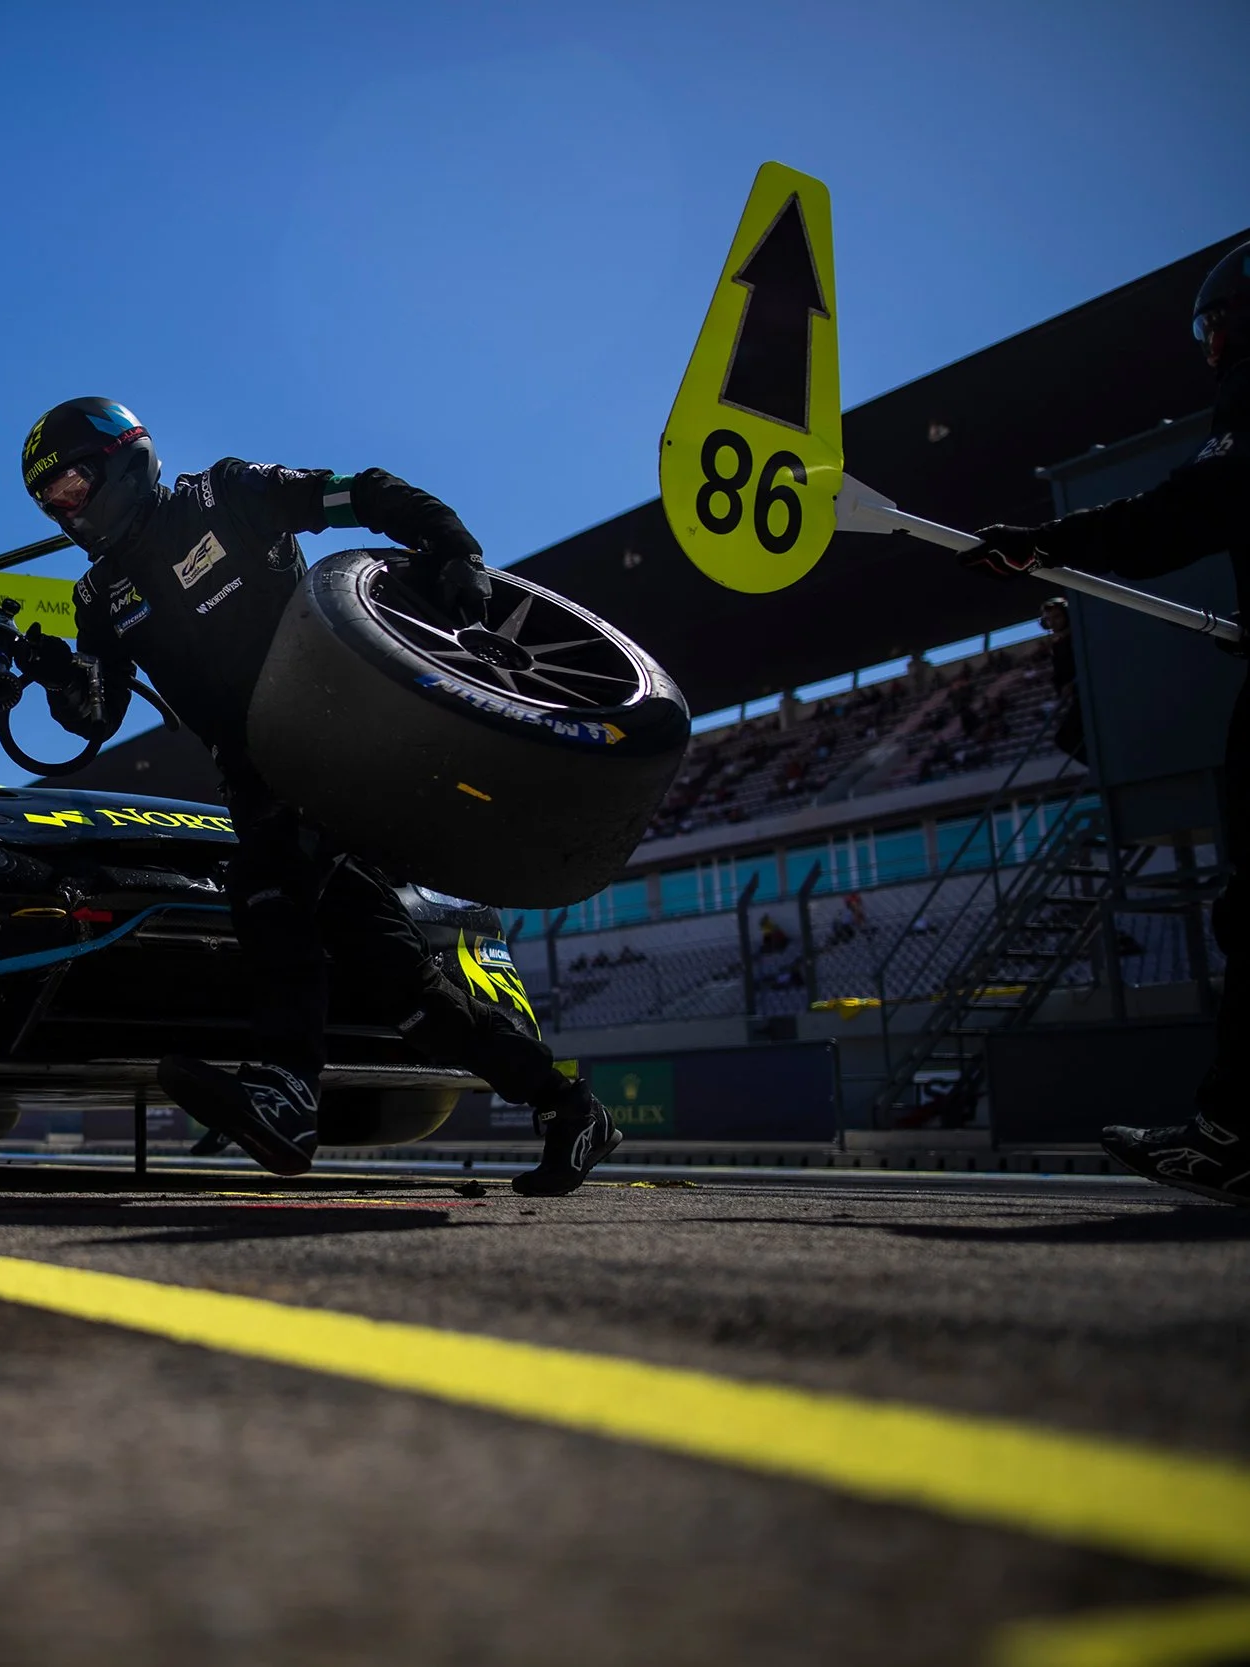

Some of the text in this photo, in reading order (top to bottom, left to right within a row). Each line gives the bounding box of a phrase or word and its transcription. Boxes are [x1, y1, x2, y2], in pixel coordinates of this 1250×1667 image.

[696, 428, 808, 555] 86
[36, 600, 71, 616] AMR
[110, 586, 143, 616] AMR
[207, 577, 244, 611] NORTHWEST
